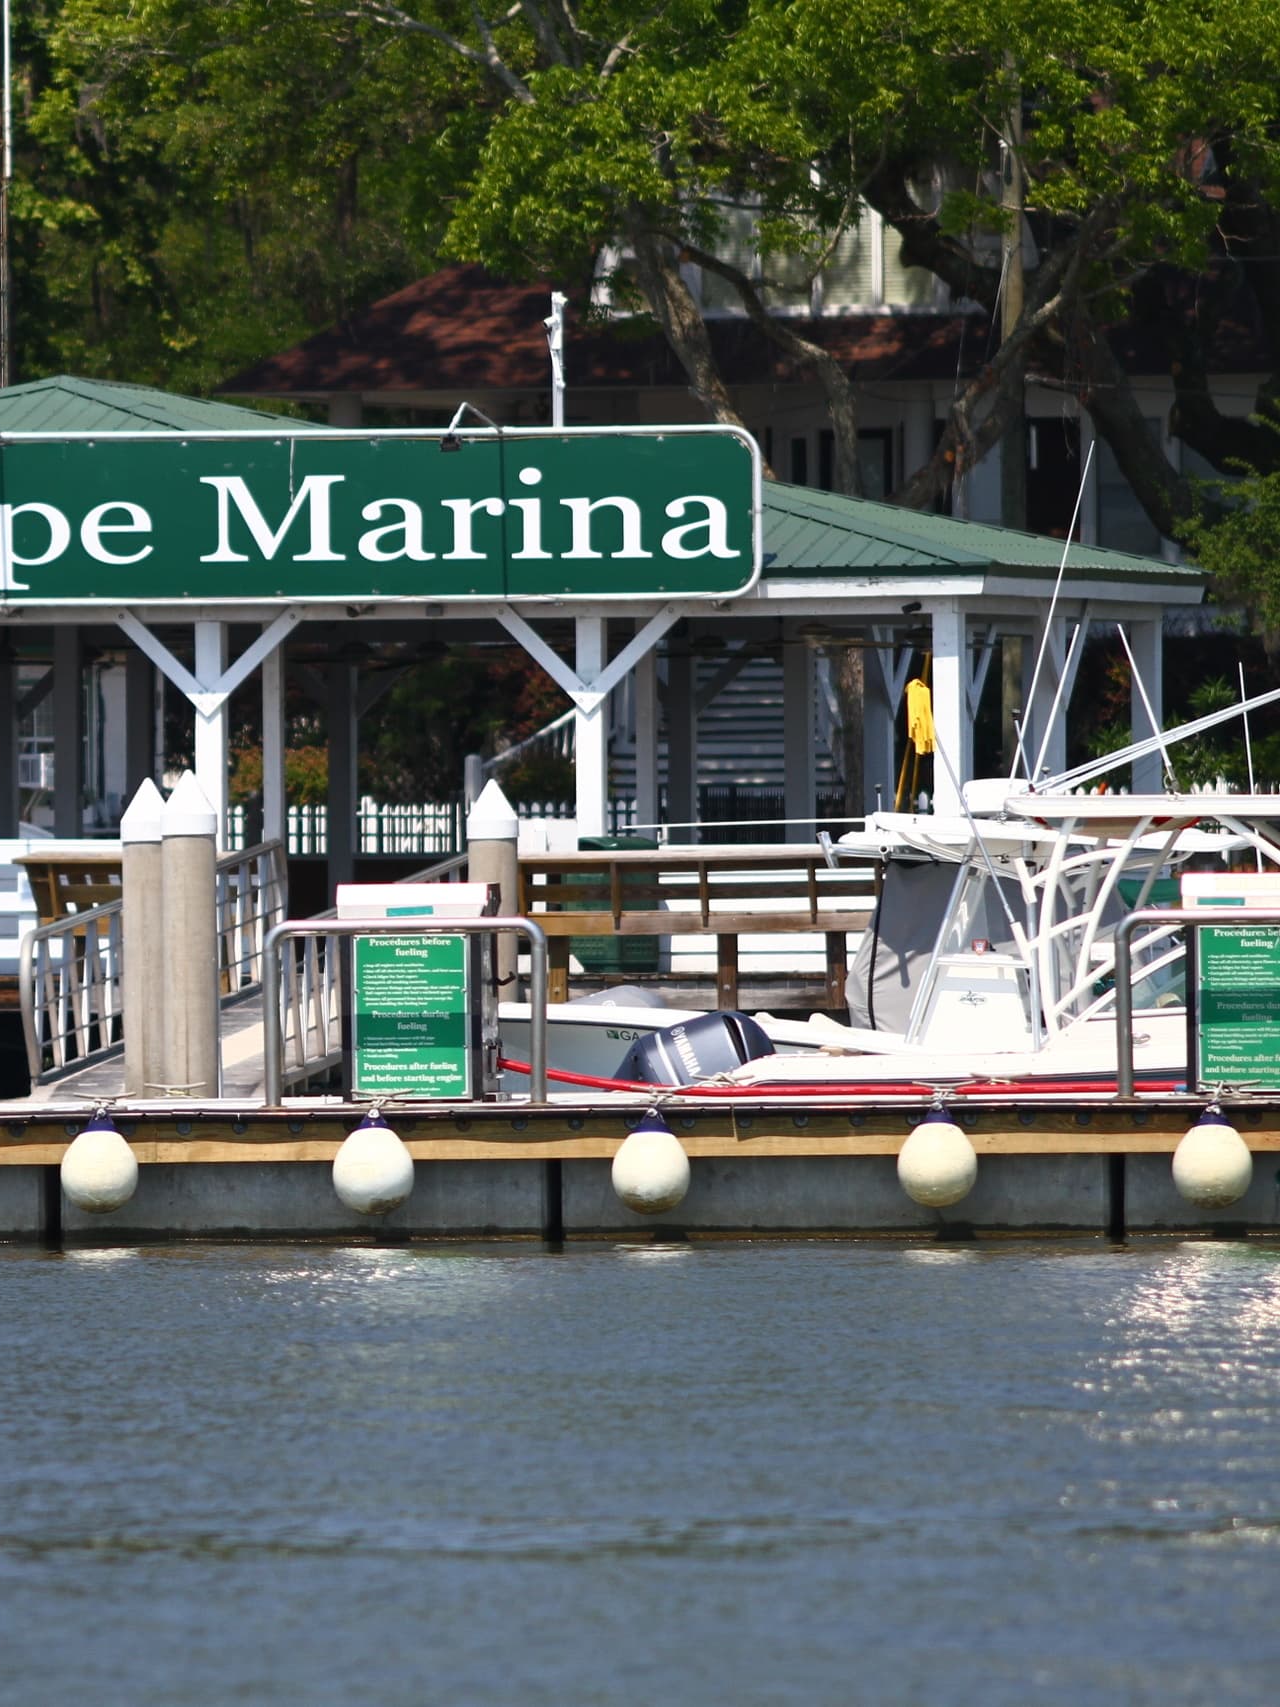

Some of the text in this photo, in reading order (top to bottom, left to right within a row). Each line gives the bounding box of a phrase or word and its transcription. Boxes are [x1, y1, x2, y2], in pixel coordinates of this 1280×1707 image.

[199, 466, 742, 562] Marina
[1214, 928, 1266, 937] Procedures
[369, 937, 452, 947] Procedures before
[1240, 938, 1274, 950] fueling
[395, 948, 428, 959] fueling
[371, 1010, 450, 1020] Procedures during
[397, 1022, 428, 1032] fueling
[620, 1031, 641, 1041] GA
[672, 1031, 702, 1077] YAMAHA
[1207, 1054, 1253, 1062] Procedures
[1253, 1053, 1273, 1062] after
[363, 1062, 458, 1072] Procedures after fueling
[1205, 1066, 1220, 1074] and
[1220, 1066, 1247, 1074] before
[361, 1073, 463, 1084] and before starting engine
